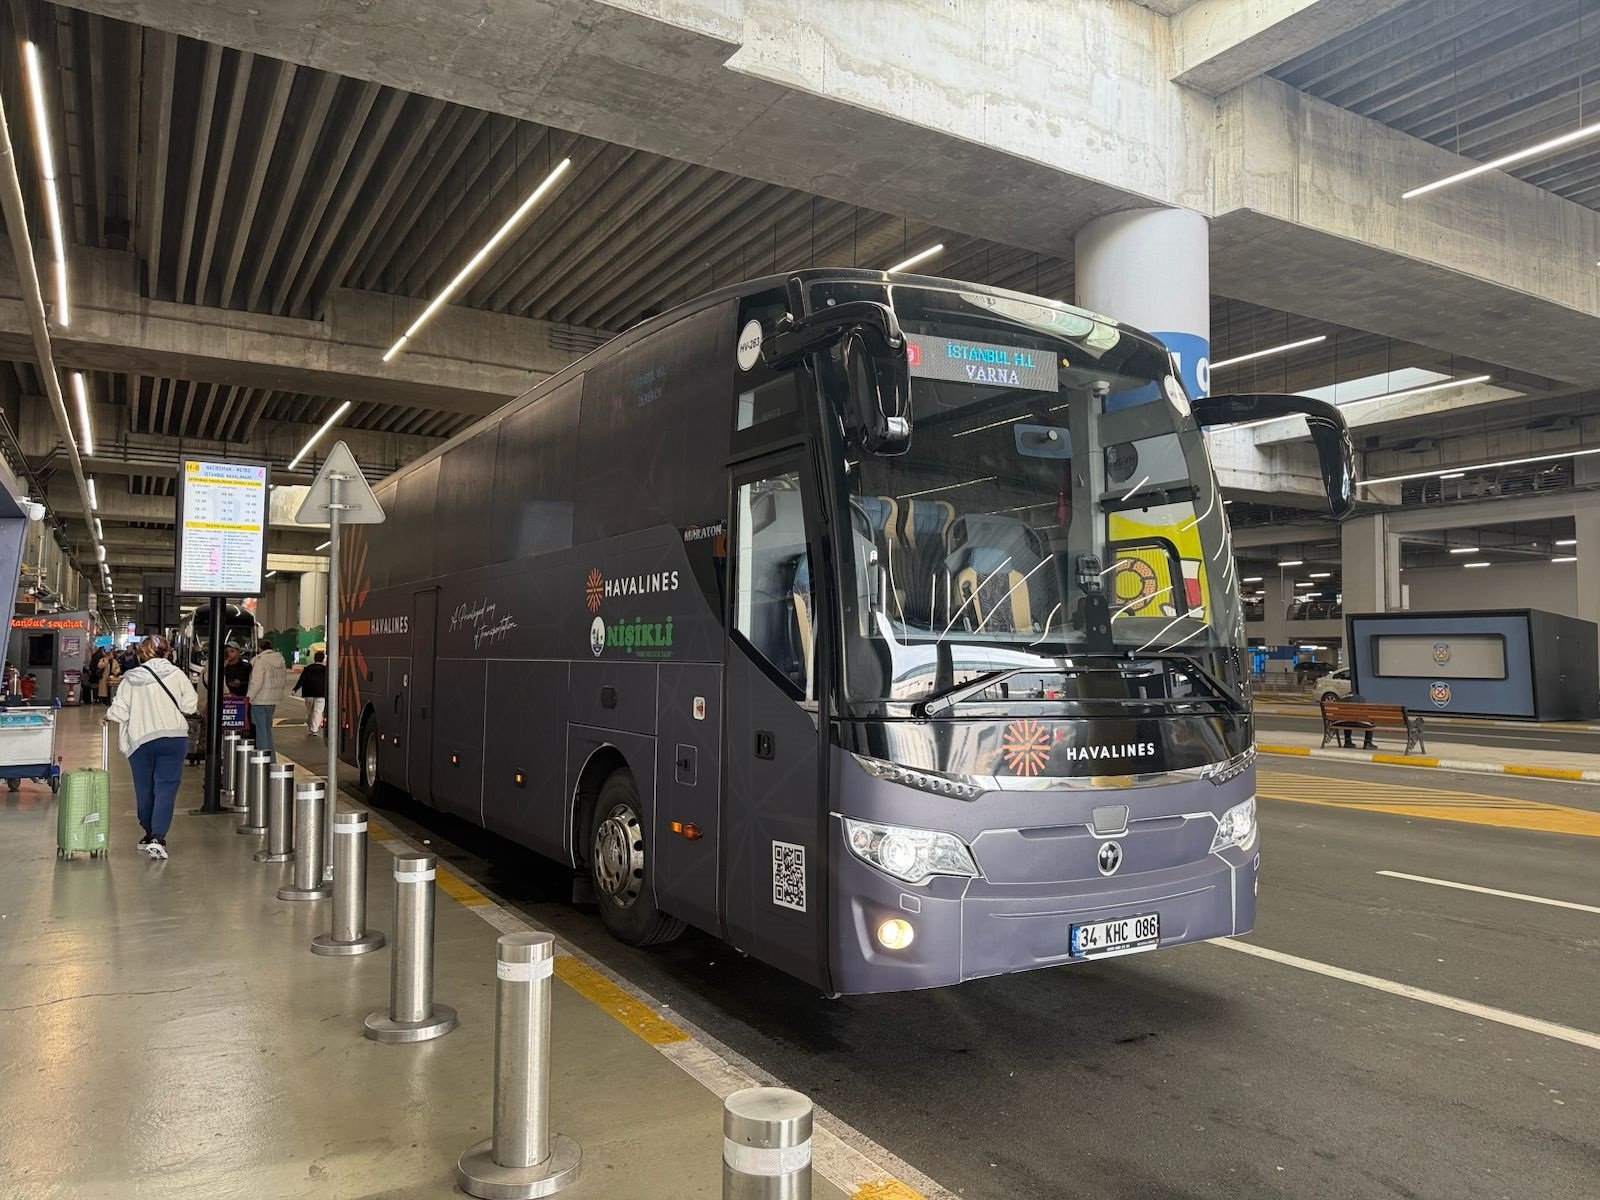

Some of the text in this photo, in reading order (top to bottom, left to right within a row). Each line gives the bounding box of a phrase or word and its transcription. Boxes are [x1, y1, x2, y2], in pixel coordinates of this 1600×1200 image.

[740, 336, 760, 354] HV-263
[945, 342, 1011, 365] İSTANBUL
[965, 365, 1020, 385] VARNA
[684, 523, 722, 541] MARATON
[605, 570, 679, 598] HAVALINES
[47, 618, 83, 629] seyahat
[371, 615, 409, 635] HAVALINES
[606, 615, 673, 654] NİŞİKLİ
[1066, 742, 1155, 761] HAVALINES
[1081, 916, 1156, 948] 34 KHC 086
